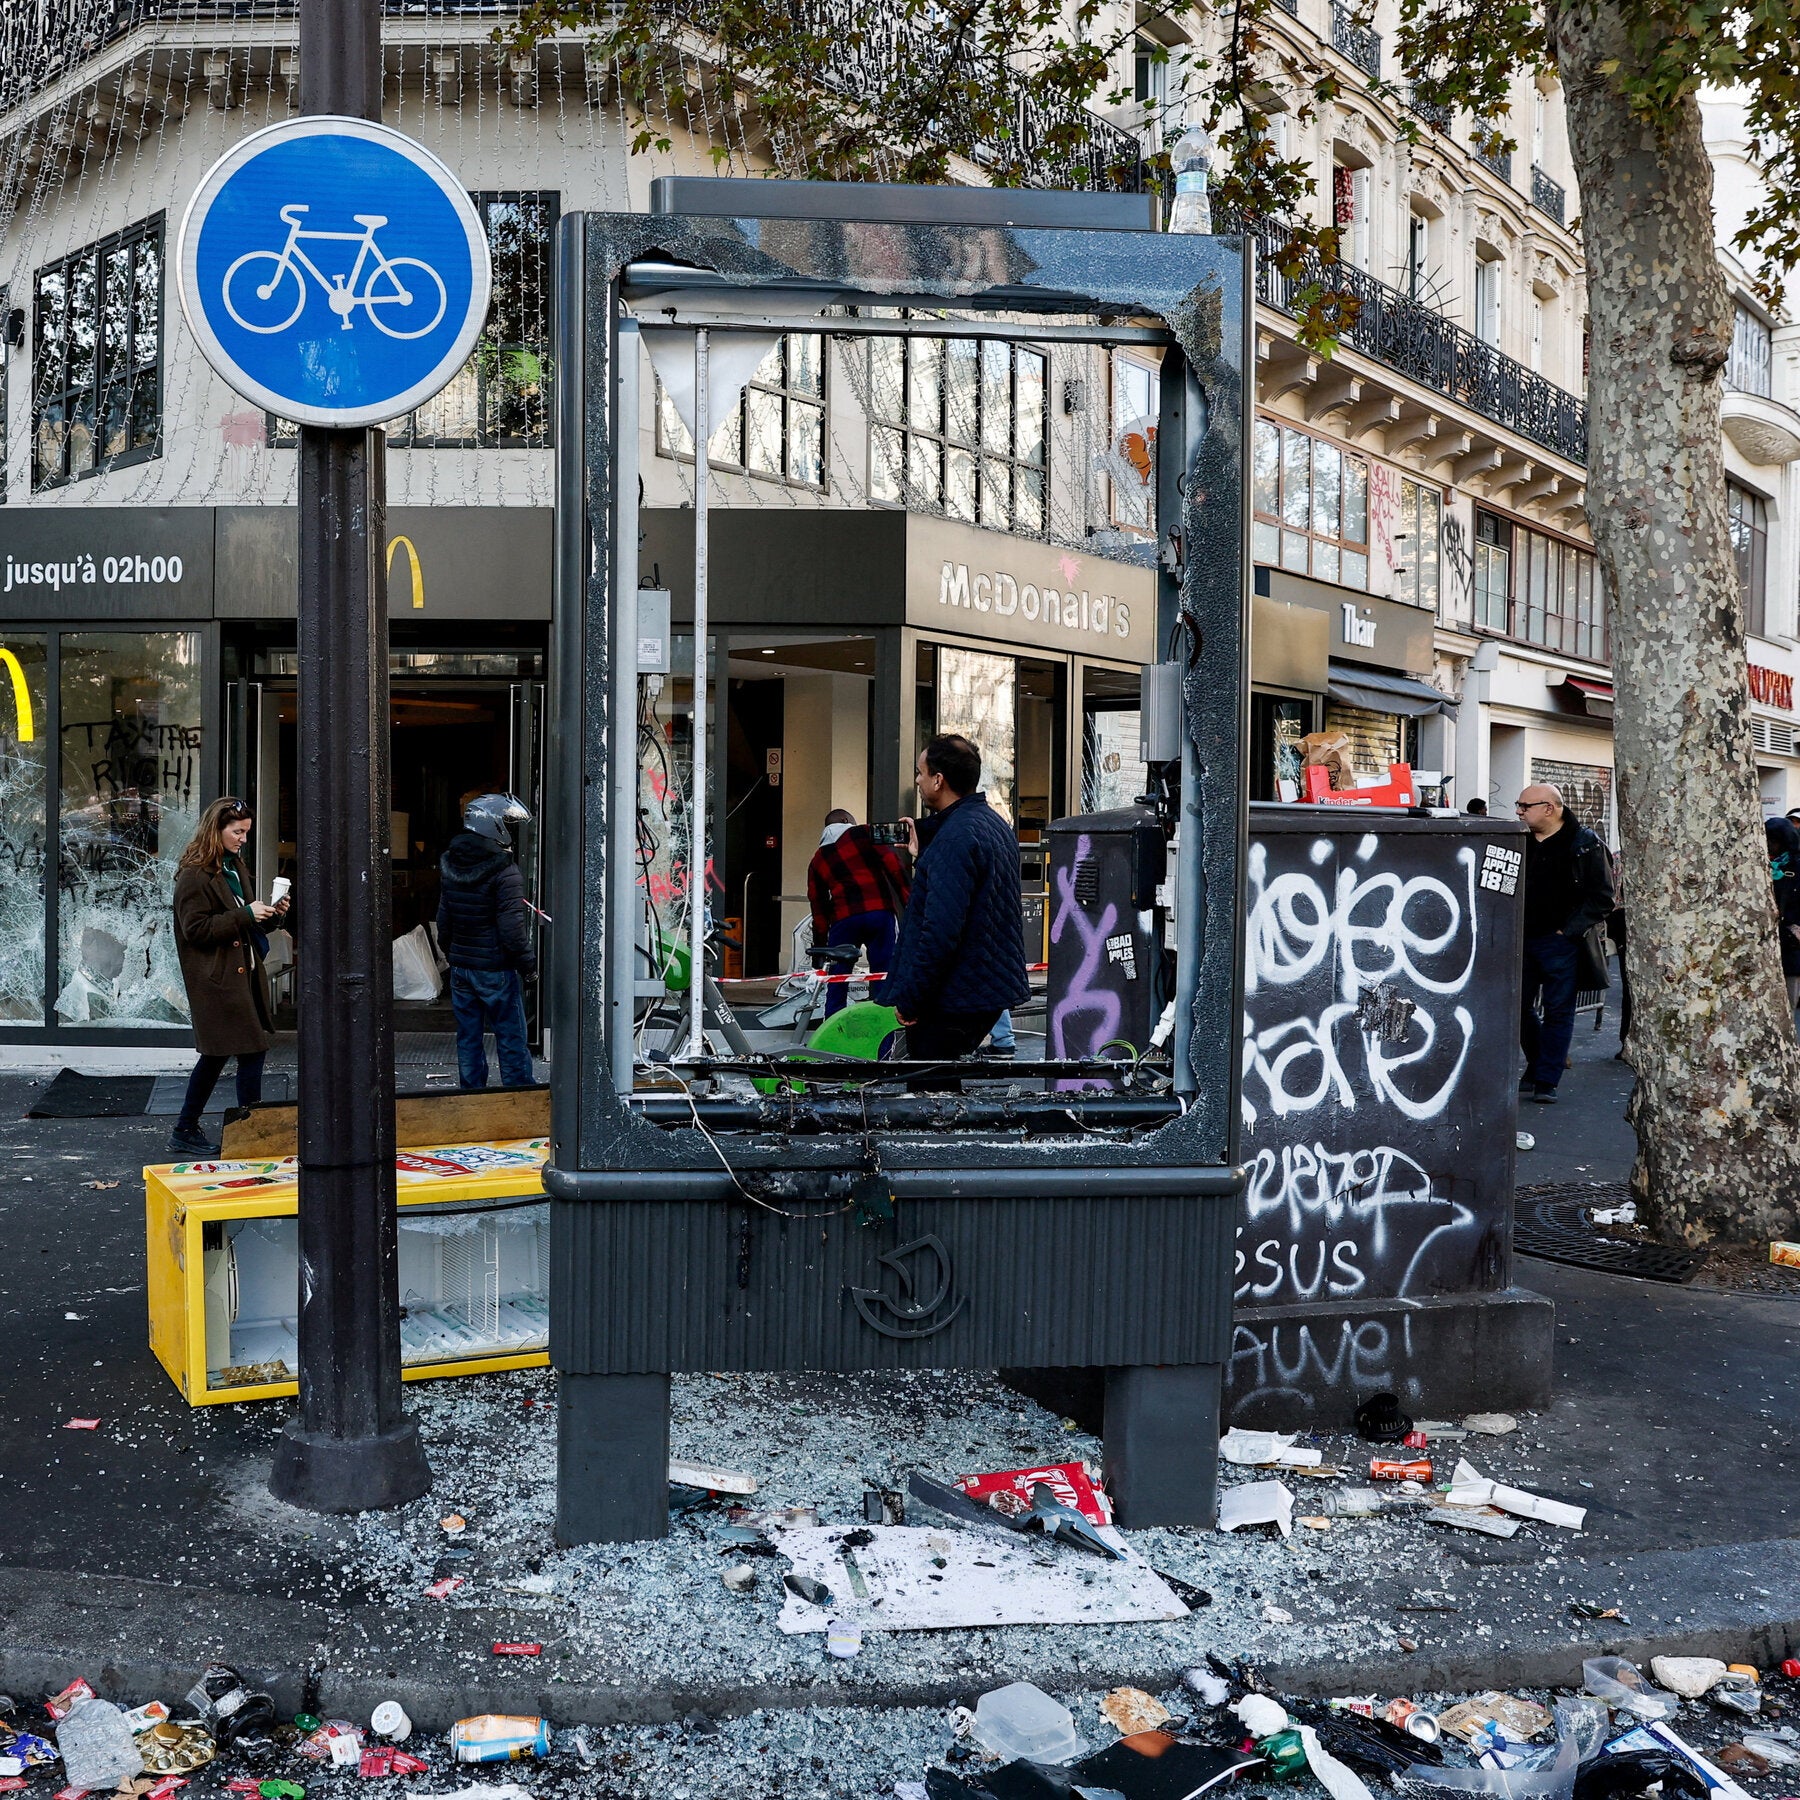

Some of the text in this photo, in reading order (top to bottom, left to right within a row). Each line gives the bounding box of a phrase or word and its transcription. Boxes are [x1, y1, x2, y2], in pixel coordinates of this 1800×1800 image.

[4, 553, 183, 592] jusqu’à 02h00
[939, 560, 1131, 639] McDonald's
[1747, 662, 1793, 711] NOPRIX
[62, 720, 205, 753] TAX THE
[1480, 869, 1502, 891] 18
[1482, 856, 1519, 877] APPLES
[1375, 1471, 1427, 1481] PULSE
